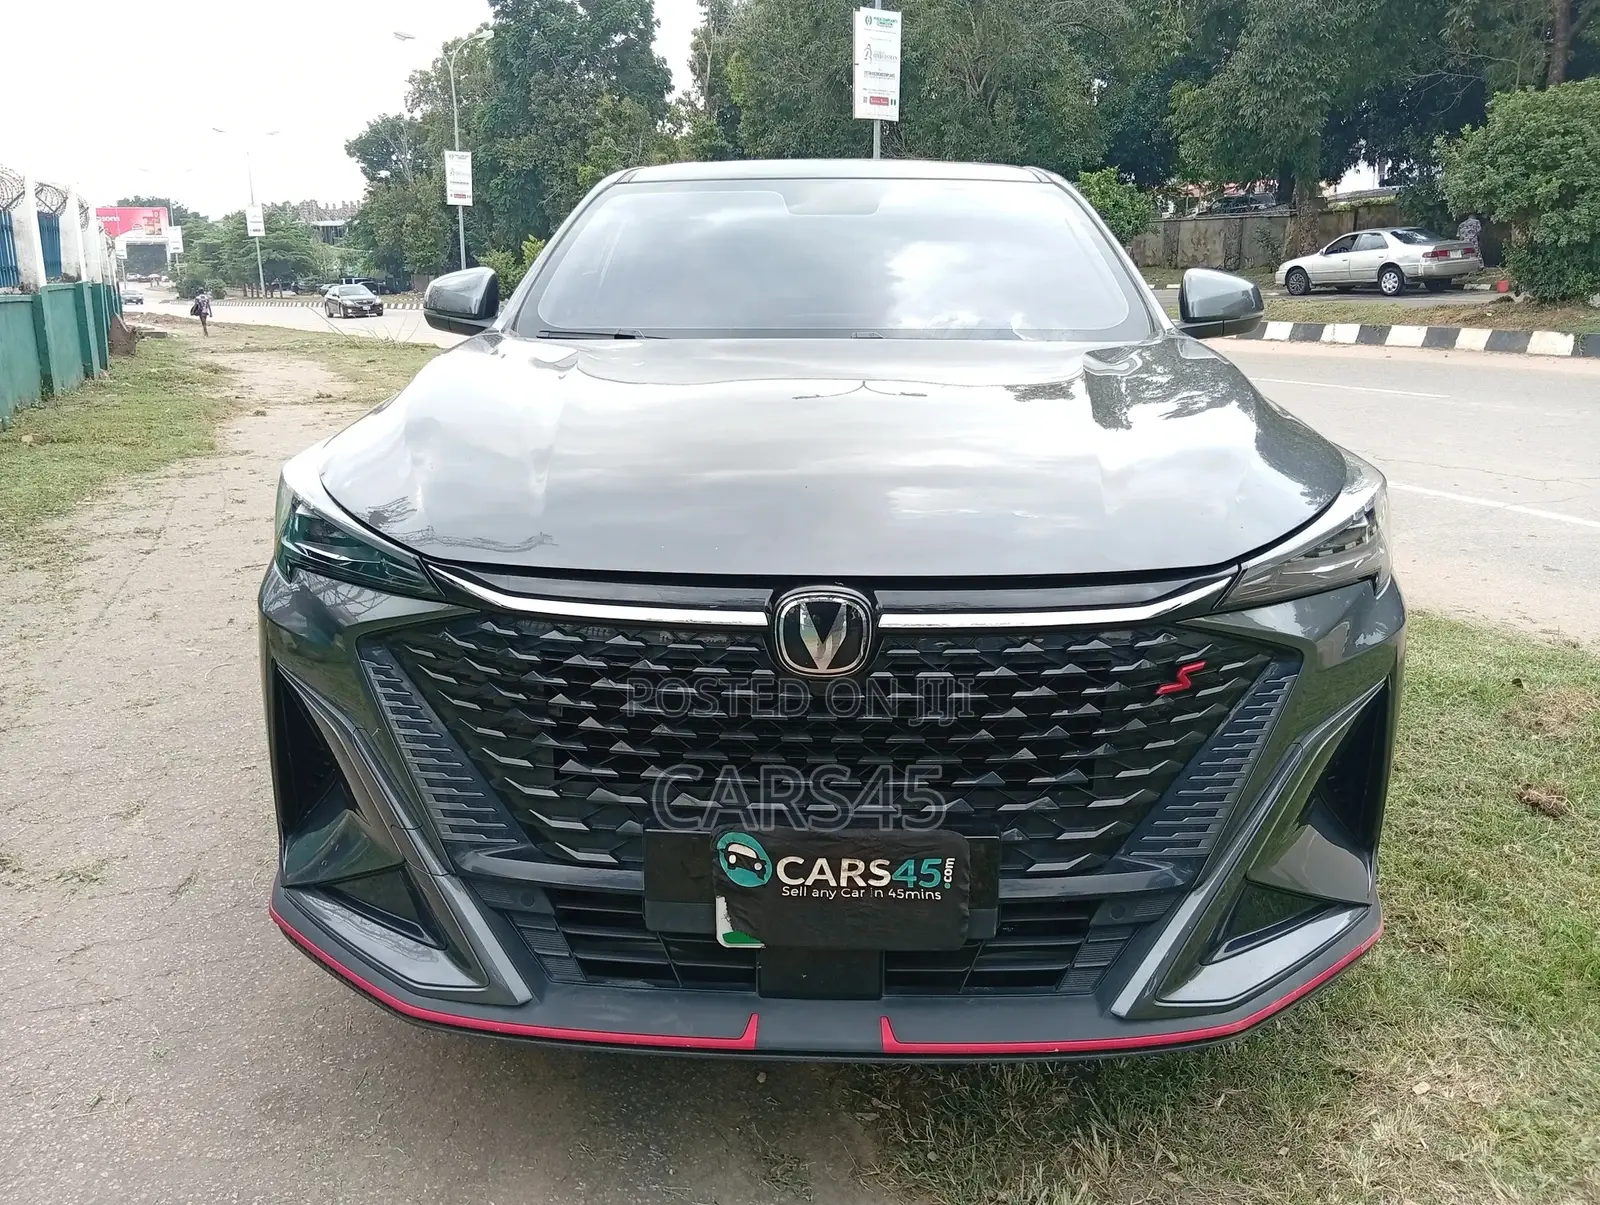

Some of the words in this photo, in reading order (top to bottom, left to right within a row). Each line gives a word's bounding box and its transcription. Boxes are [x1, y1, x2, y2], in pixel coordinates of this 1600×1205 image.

[776, 856, 943, 889] CARS45
[781, 885, 808, 897] Sell
[811, 888, 837, 900] any
[840, 887, 865, 898] Car
[869, 887, 884, 898] in
[888, 888, 942, 901] 45mins
